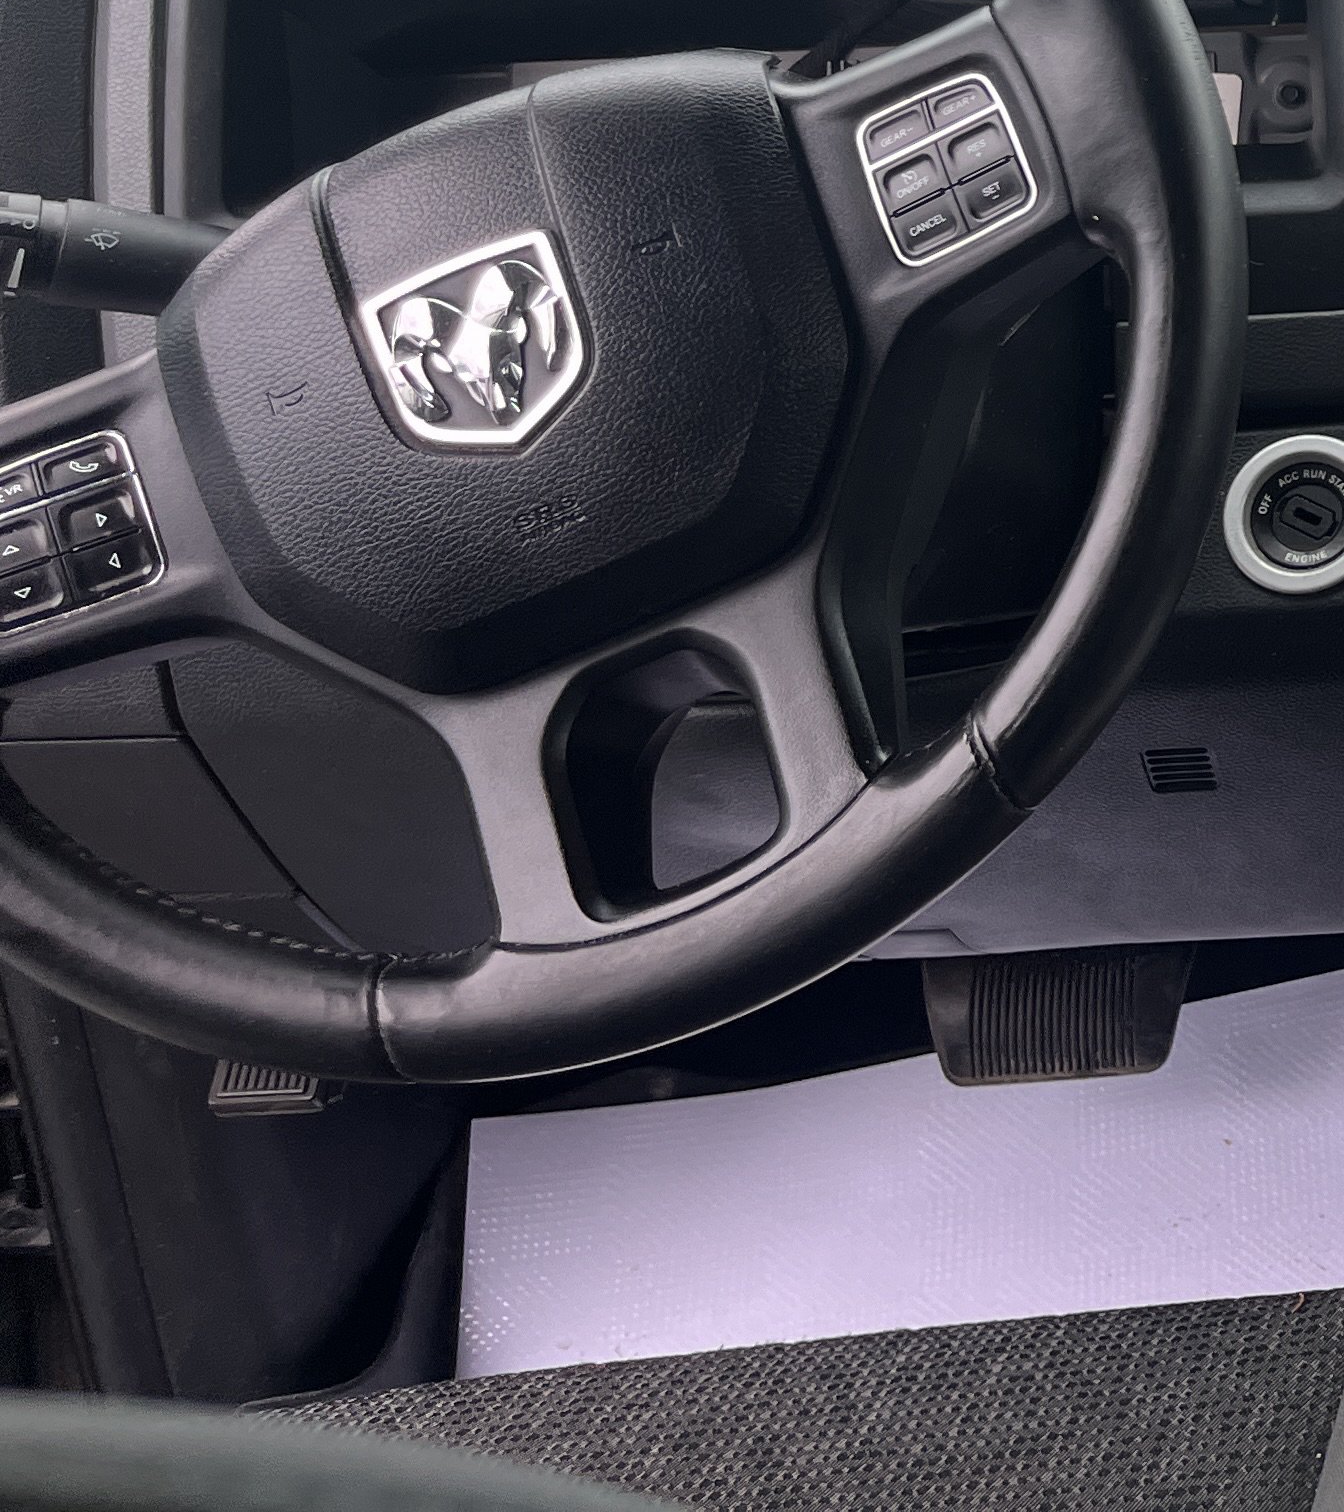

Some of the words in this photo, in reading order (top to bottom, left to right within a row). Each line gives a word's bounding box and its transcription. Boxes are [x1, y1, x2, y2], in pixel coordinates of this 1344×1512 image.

[966, 139, 987, 155] RES
[982, 181, 1001, 198] SET
[909, 214, 947, 237] CANCEL
[4, 483, 23, 497] VR
[1258, 493, 1273, 515] OFF
[1277, 471, 1300, 488] ACC
[1303, 469, 1326, 481] RUN
[1284, 550, 1328, 563] ENGINE
